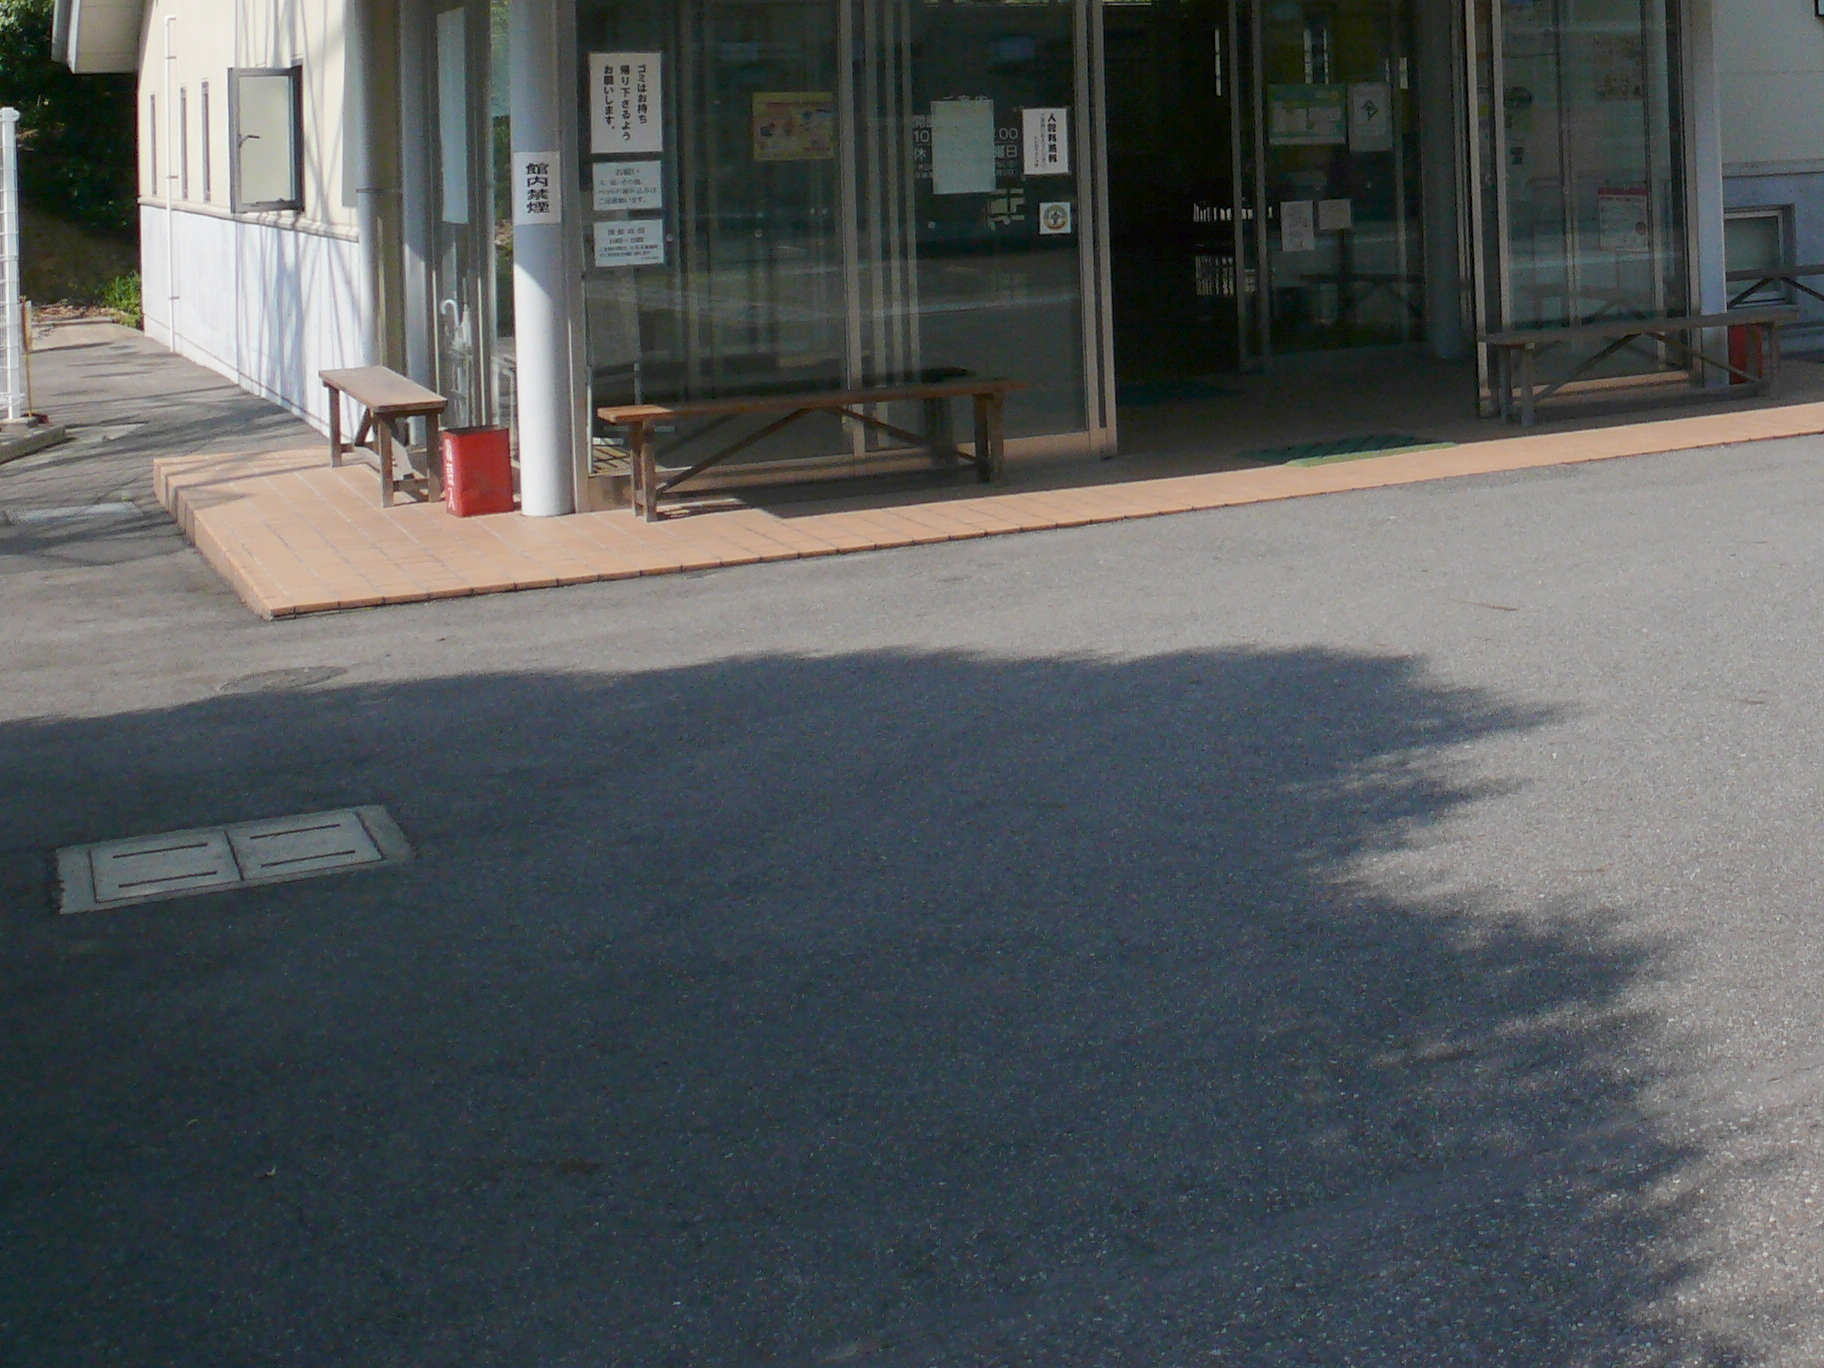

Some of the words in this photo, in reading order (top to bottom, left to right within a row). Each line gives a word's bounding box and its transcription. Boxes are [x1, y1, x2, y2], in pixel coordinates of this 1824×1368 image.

[603, 65, 616, 130] お願いします。
[620, 64, 631, 142] 帰り下さるよう
[637, 64, 648, 125] ゴミはお持ち
[525, 162, 550, 214] 館内禁煙
